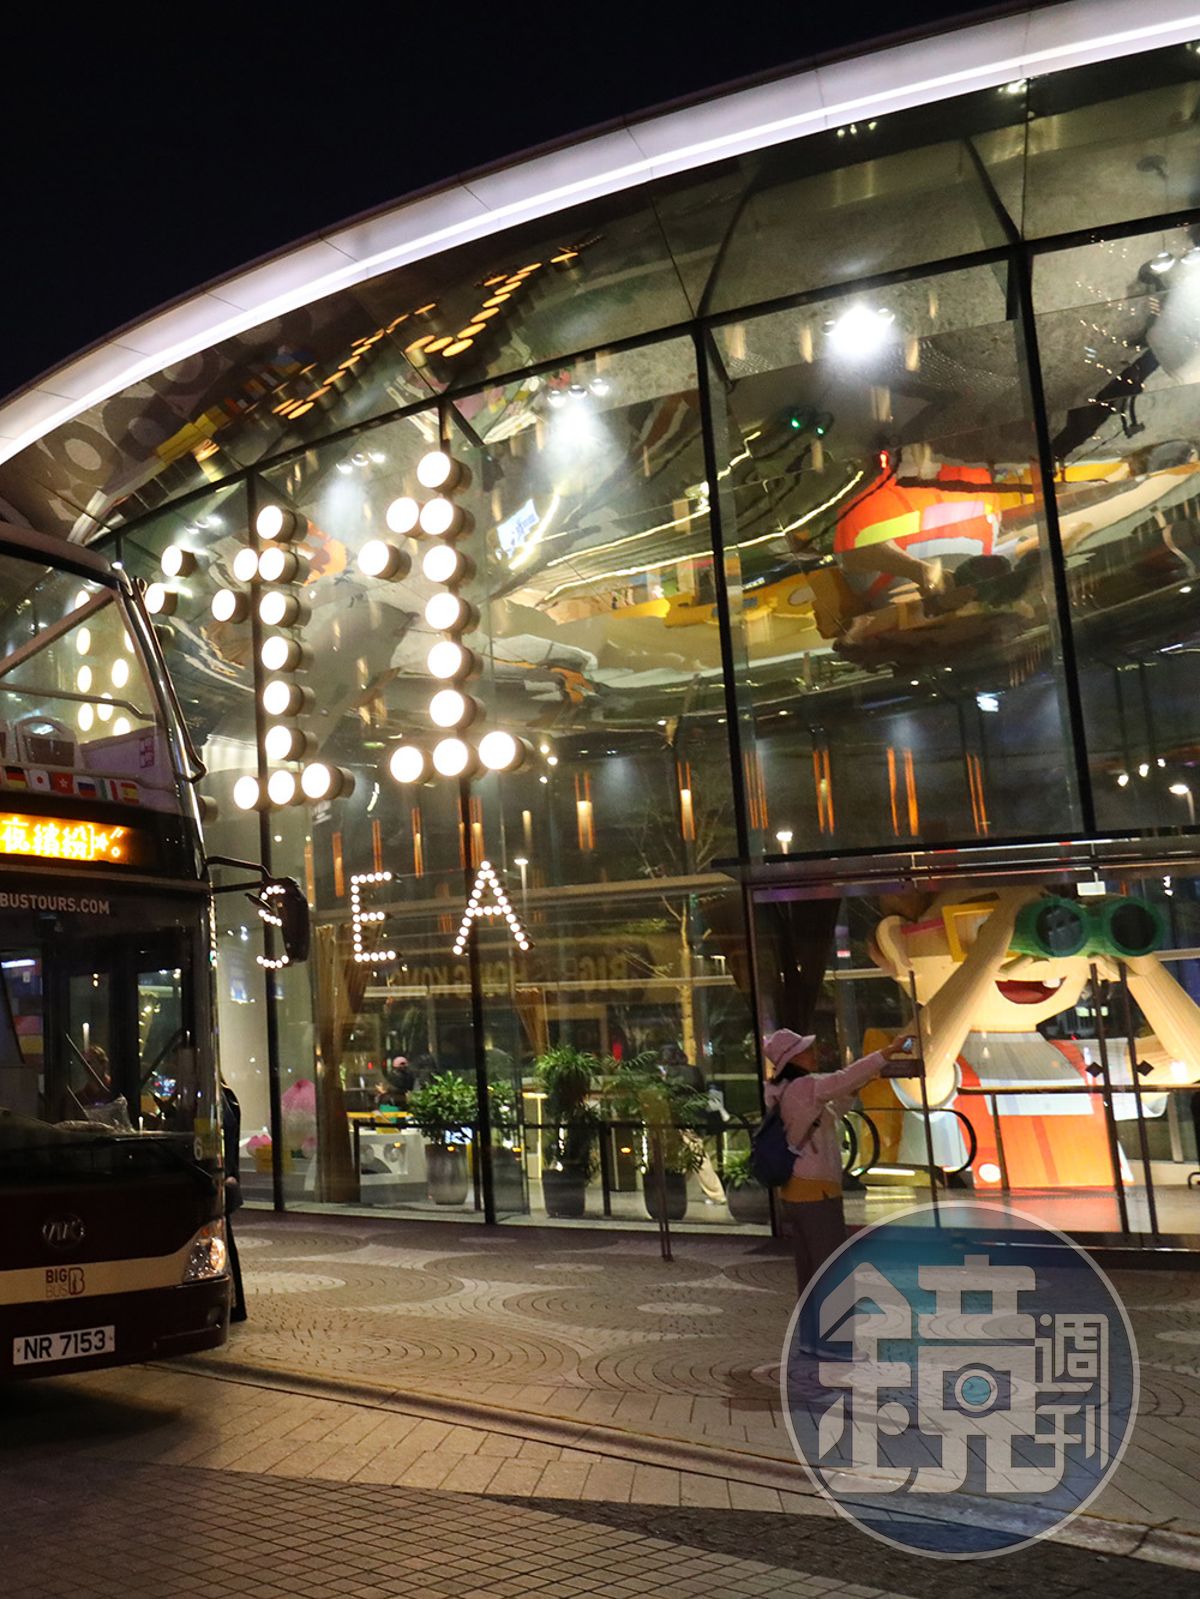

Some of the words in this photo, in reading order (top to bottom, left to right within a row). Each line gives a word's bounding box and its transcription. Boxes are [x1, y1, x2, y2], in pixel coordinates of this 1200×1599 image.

[45, 1268, 68, 1284] BIG
[24, 1337, 51, 1361] NR
[61, 1330, 105, 1356] 7153
